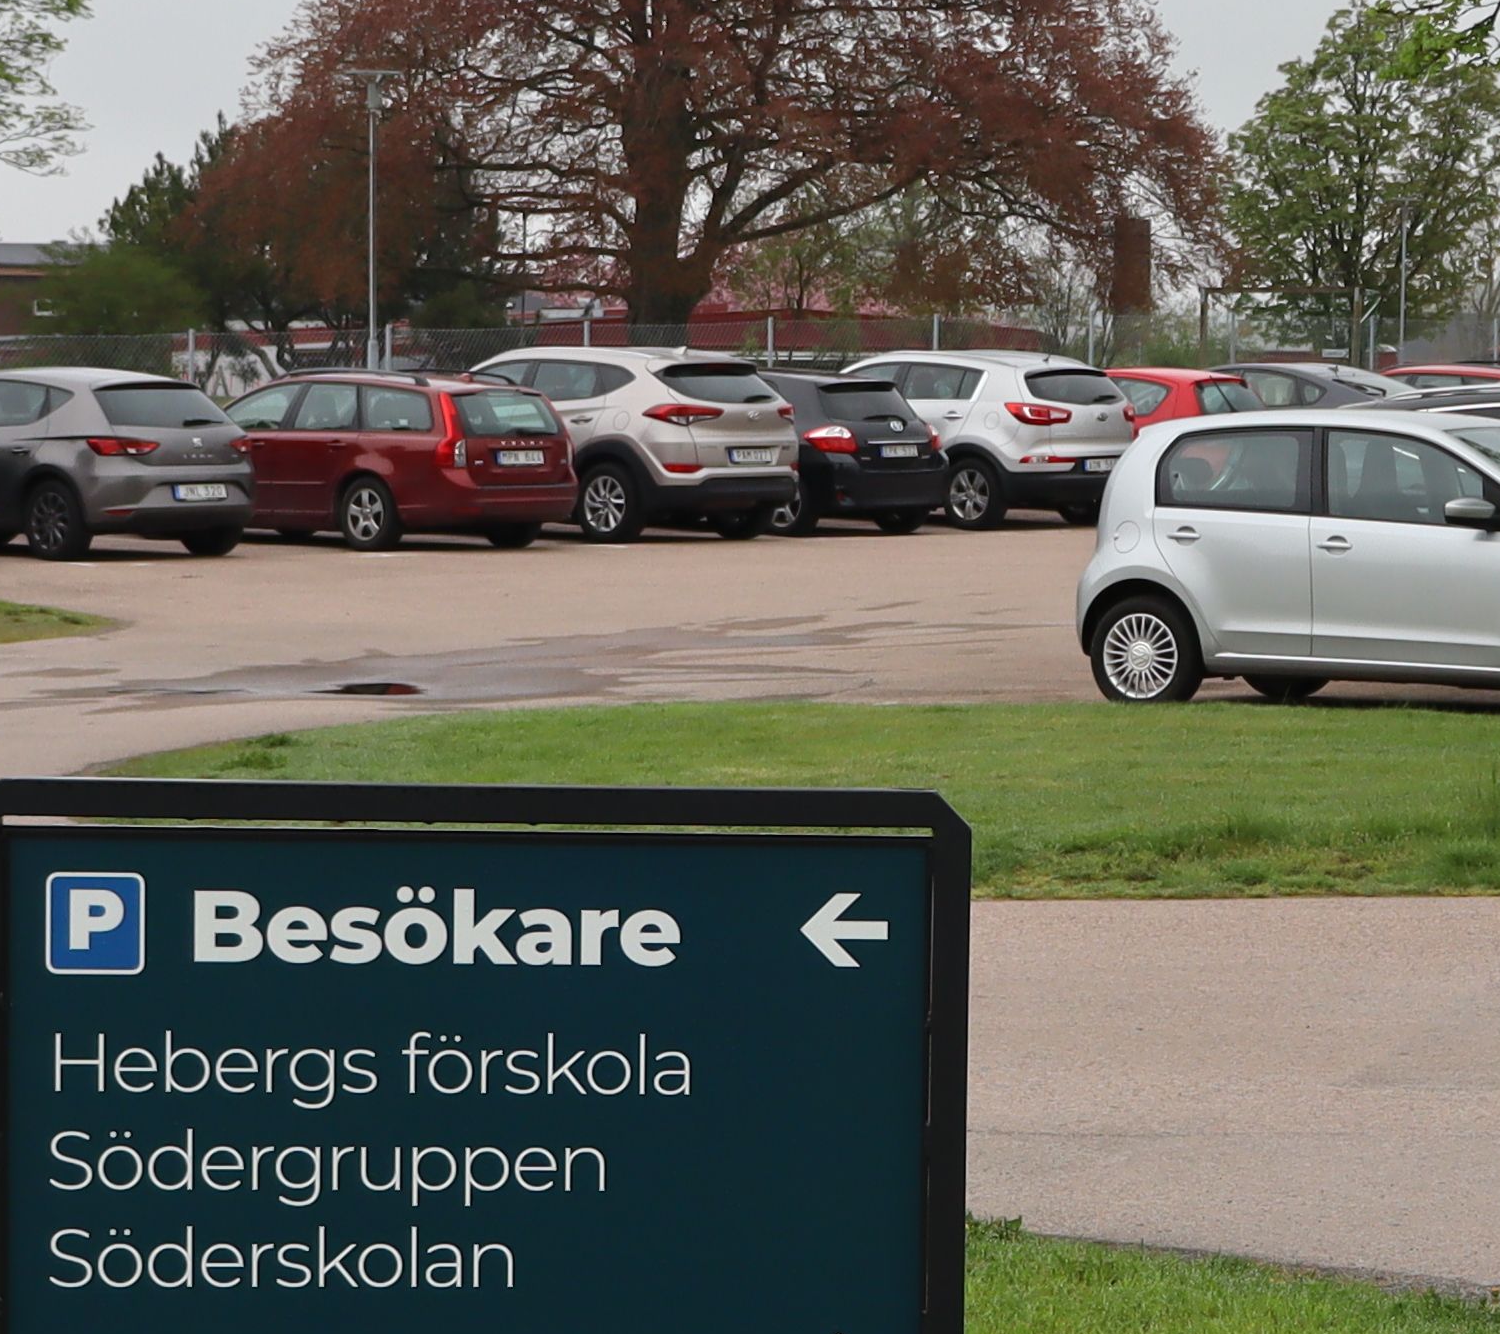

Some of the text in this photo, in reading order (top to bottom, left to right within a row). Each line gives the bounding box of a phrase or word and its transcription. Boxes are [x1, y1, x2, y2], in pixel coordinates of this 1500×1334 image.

[70, 886, 681, 967] P Besökare
[54, 1030, 691, 1109] Hebergs förskola
[49, 1128, 605, 1207] Södergruppen
[49, 1225, 514, 1288] Söderskolan
